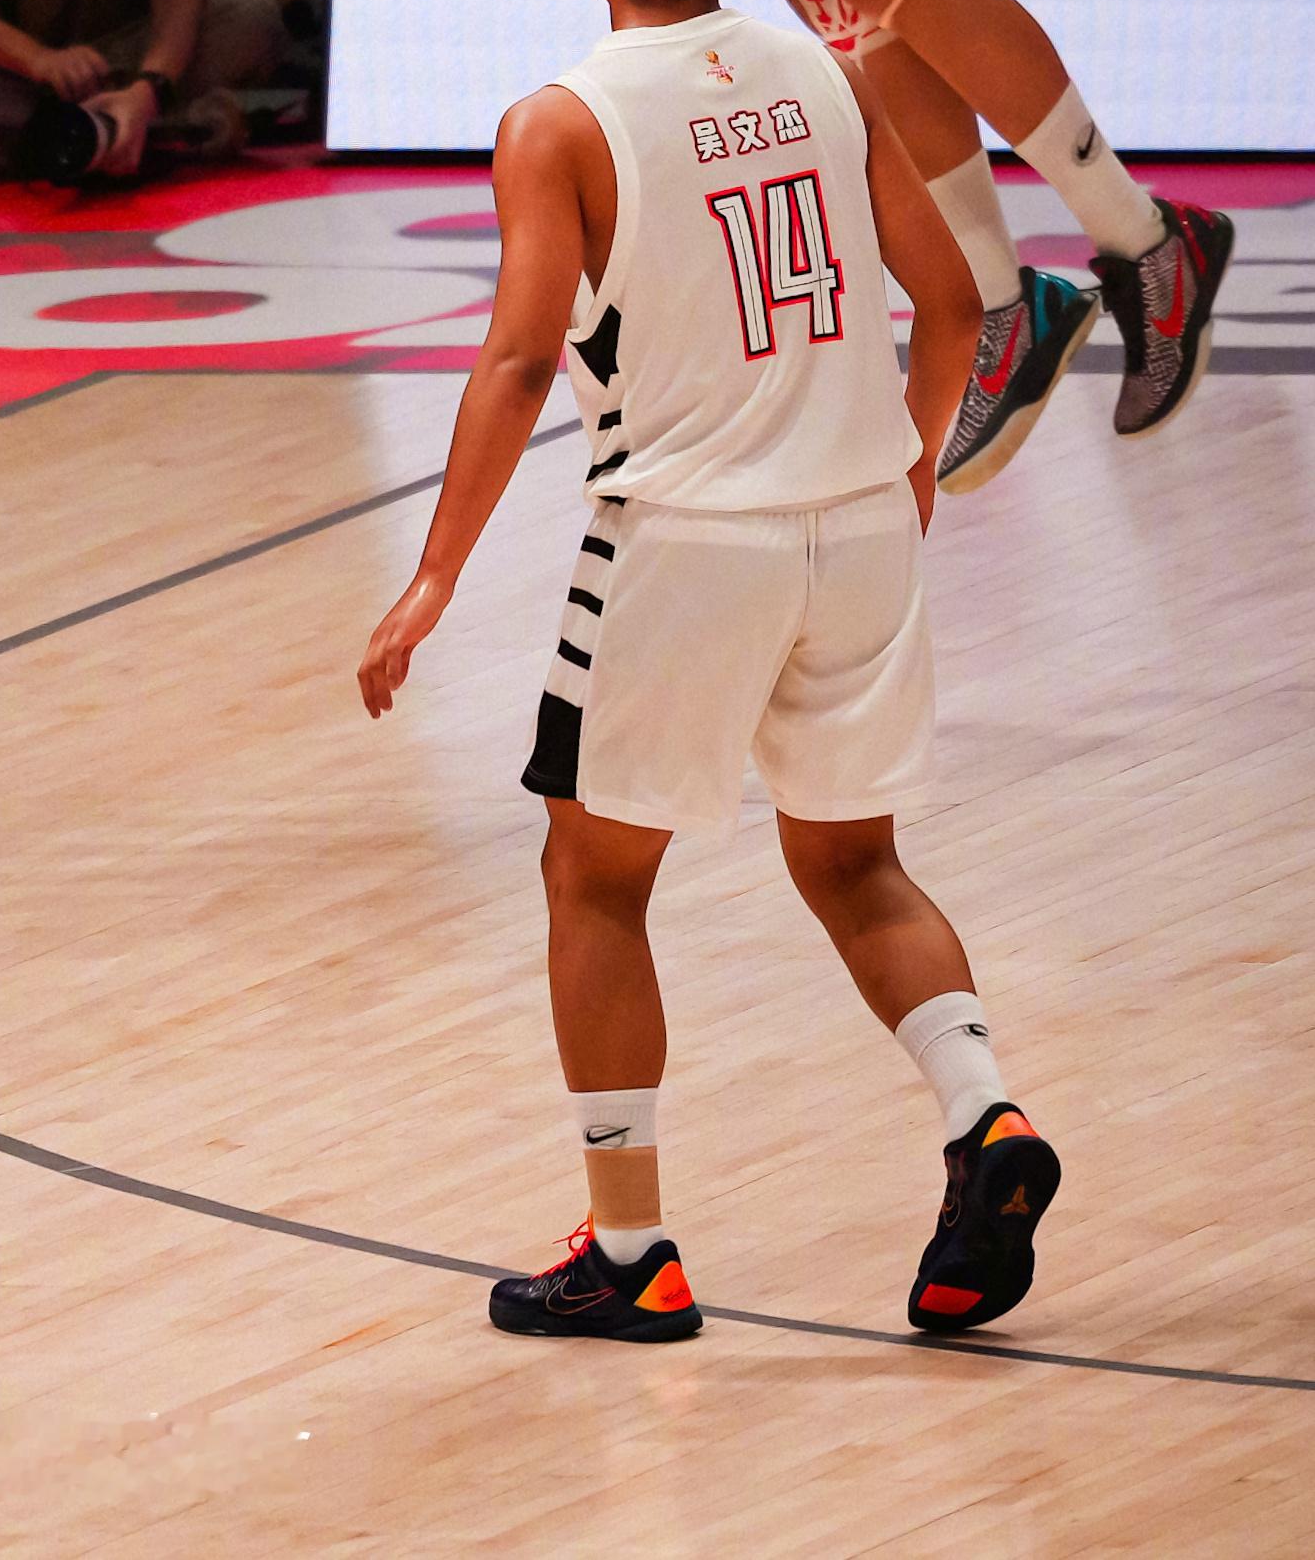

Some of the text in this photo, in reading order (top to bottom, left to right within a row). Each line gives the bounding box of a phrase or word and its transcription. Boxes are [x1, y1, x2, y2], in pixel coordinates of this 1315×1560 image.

[690, 99, 811, 163] 吴文杰
[705, 169, 845, 361] 14
